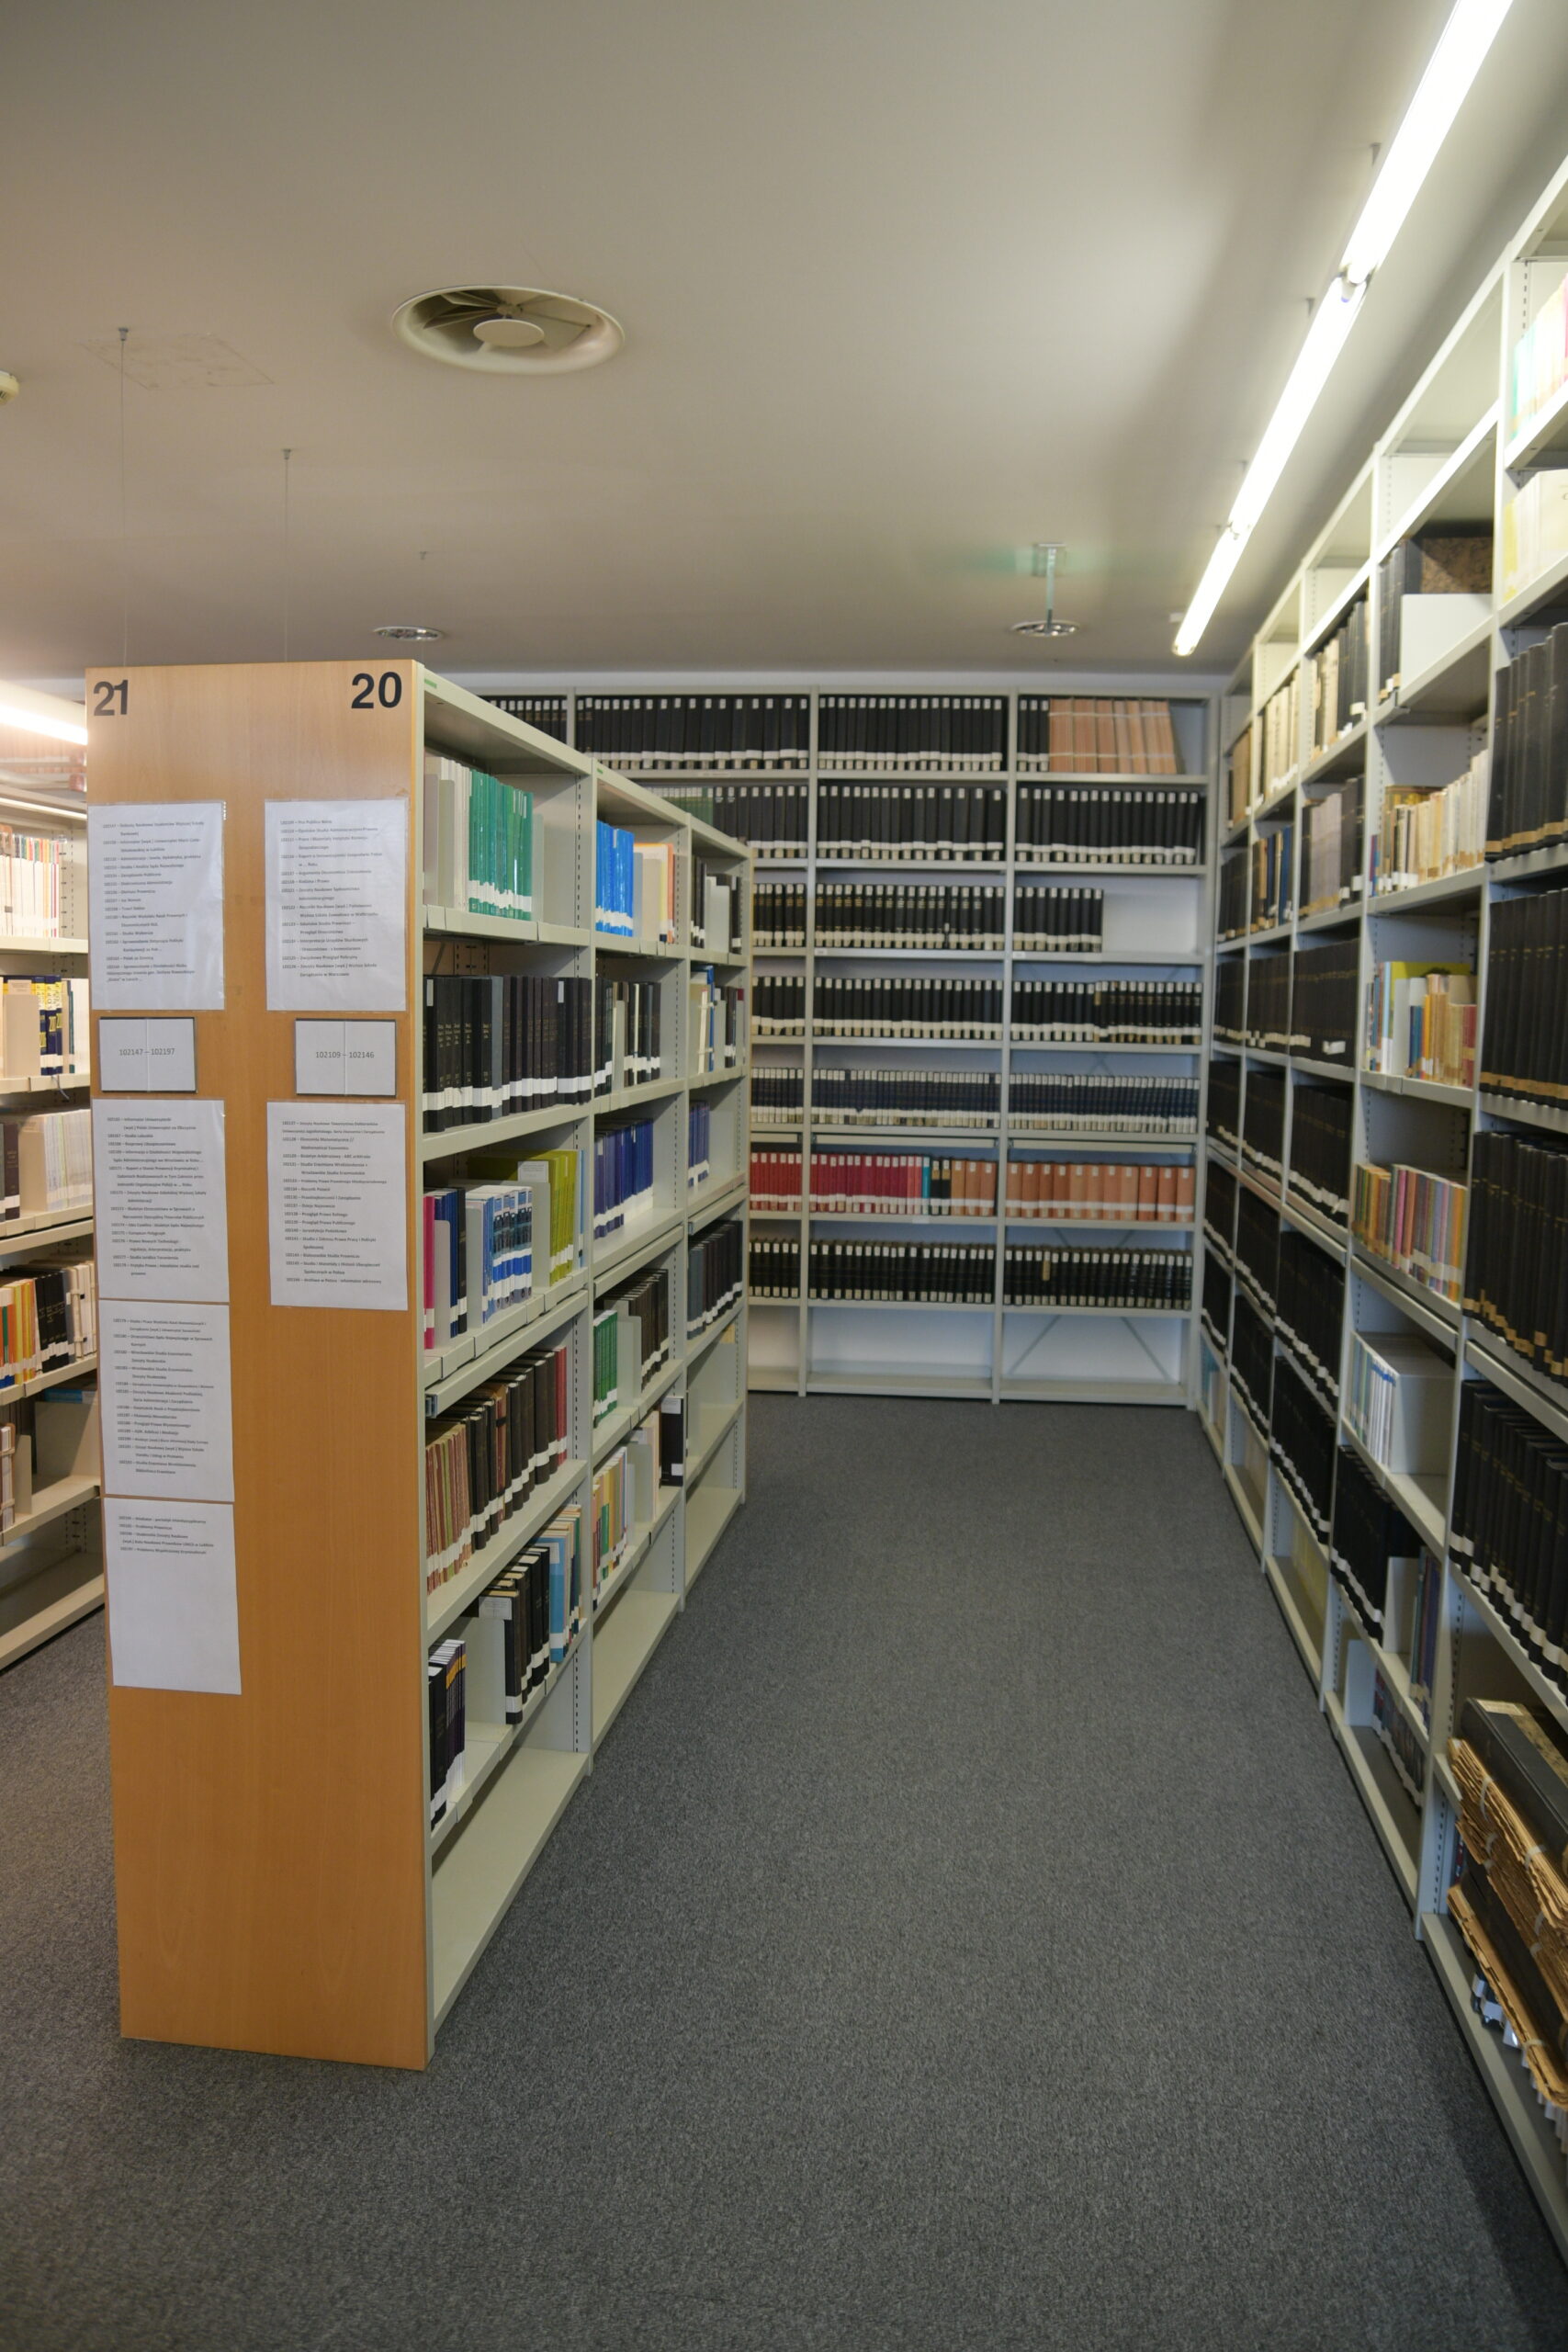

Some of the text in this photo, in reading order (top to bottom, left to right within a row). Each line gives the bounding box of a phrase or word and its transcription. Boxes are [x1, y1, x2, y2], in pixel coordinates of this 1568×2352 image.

[93, 680, 130, 717] 21
[351, 672, 402, 709] 20
[151, 1047, 175, 1056] 102197
